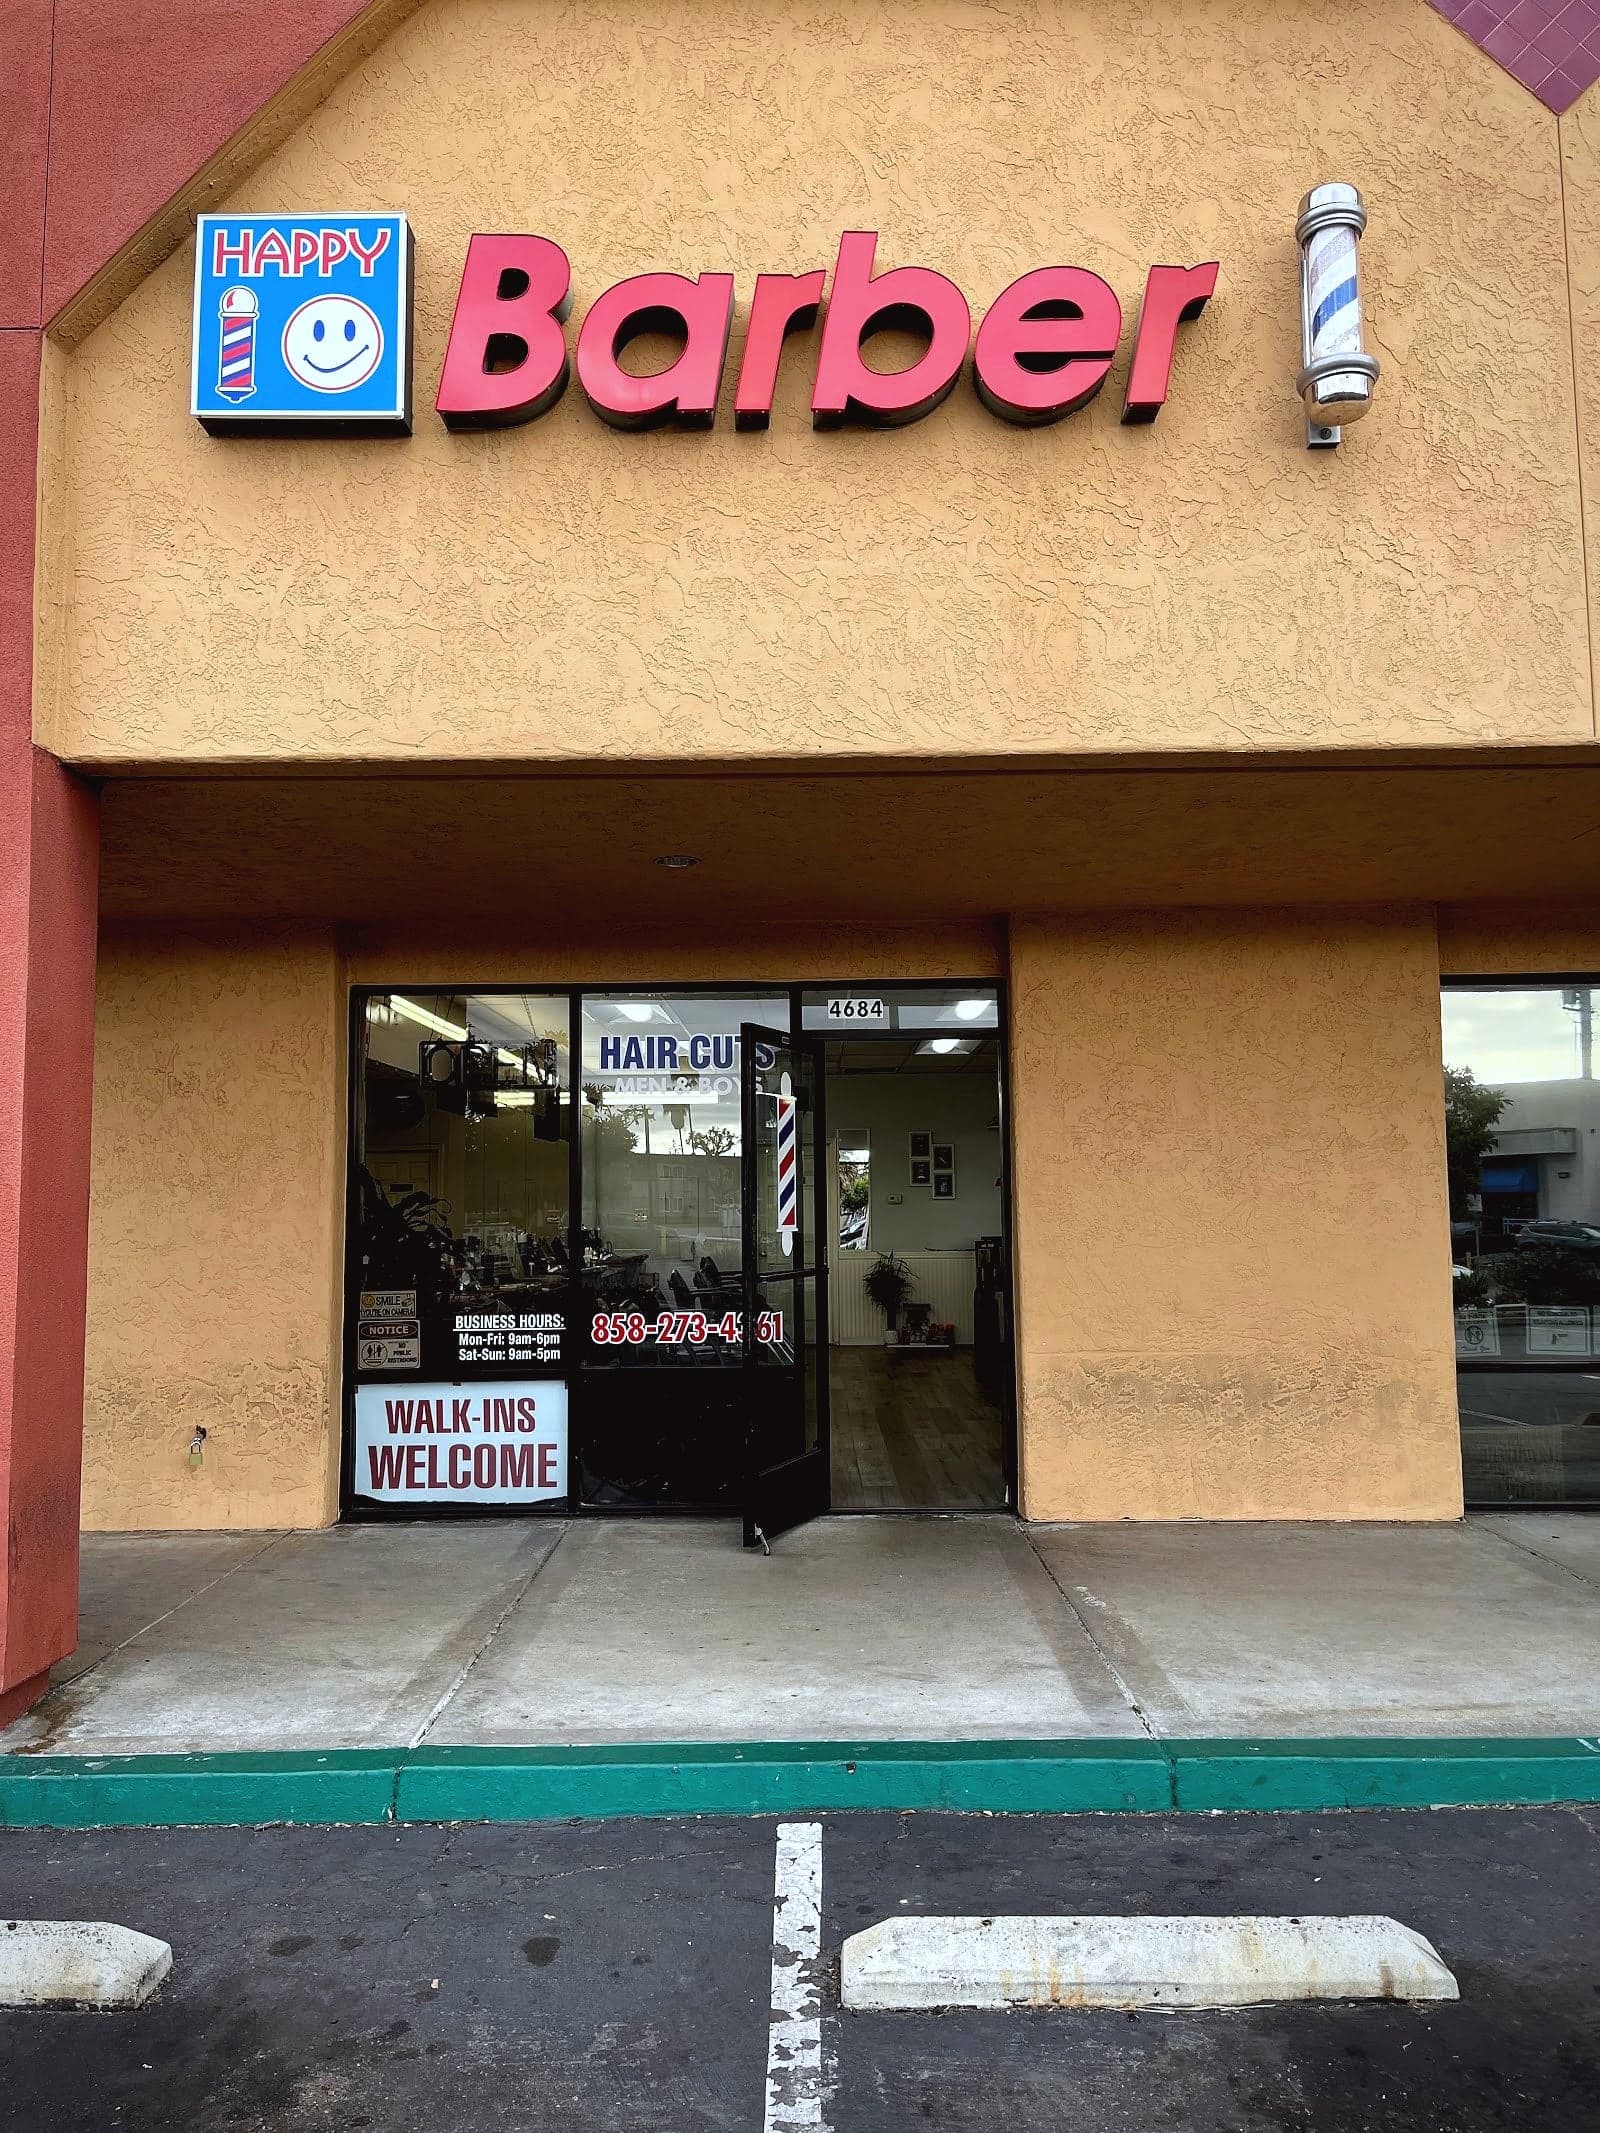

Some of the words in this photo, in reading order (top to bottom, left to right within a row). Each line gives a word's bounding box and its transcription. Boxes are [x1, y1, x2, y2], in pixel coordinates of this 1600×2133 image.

[213, 228, 391, 277] HAPPY
[436, 230, 1220, 418] Barber
[829, 1000, 882, 1018] 4684
[600, 1035, 679, 1070] HAIR
[614, 1077, 667, 1095] MEN
[673, 1076, 692, 1095] &
[376, 1296, 401, 1306] SMILE
[369, 1326, 409, 1335] NOTICE
[455, 1315, 516, 1329] BUSINESS
[519, 1313, 565, 1328] HOURS:
[591, 1311, 784, 1344] 858-273-461
[459, 1332, 505, 1346] Mon-Fri:
[508, 1332, 560, 1347] 9am-6pm
[459, 1348, 506, 1361] Sat-Sun:
[508, 1347, 561, 1362] 9am-5pm
[385, 1398, 536, 1434] WALK-INS
[368, 1443, 558, 1489] WELCOME
